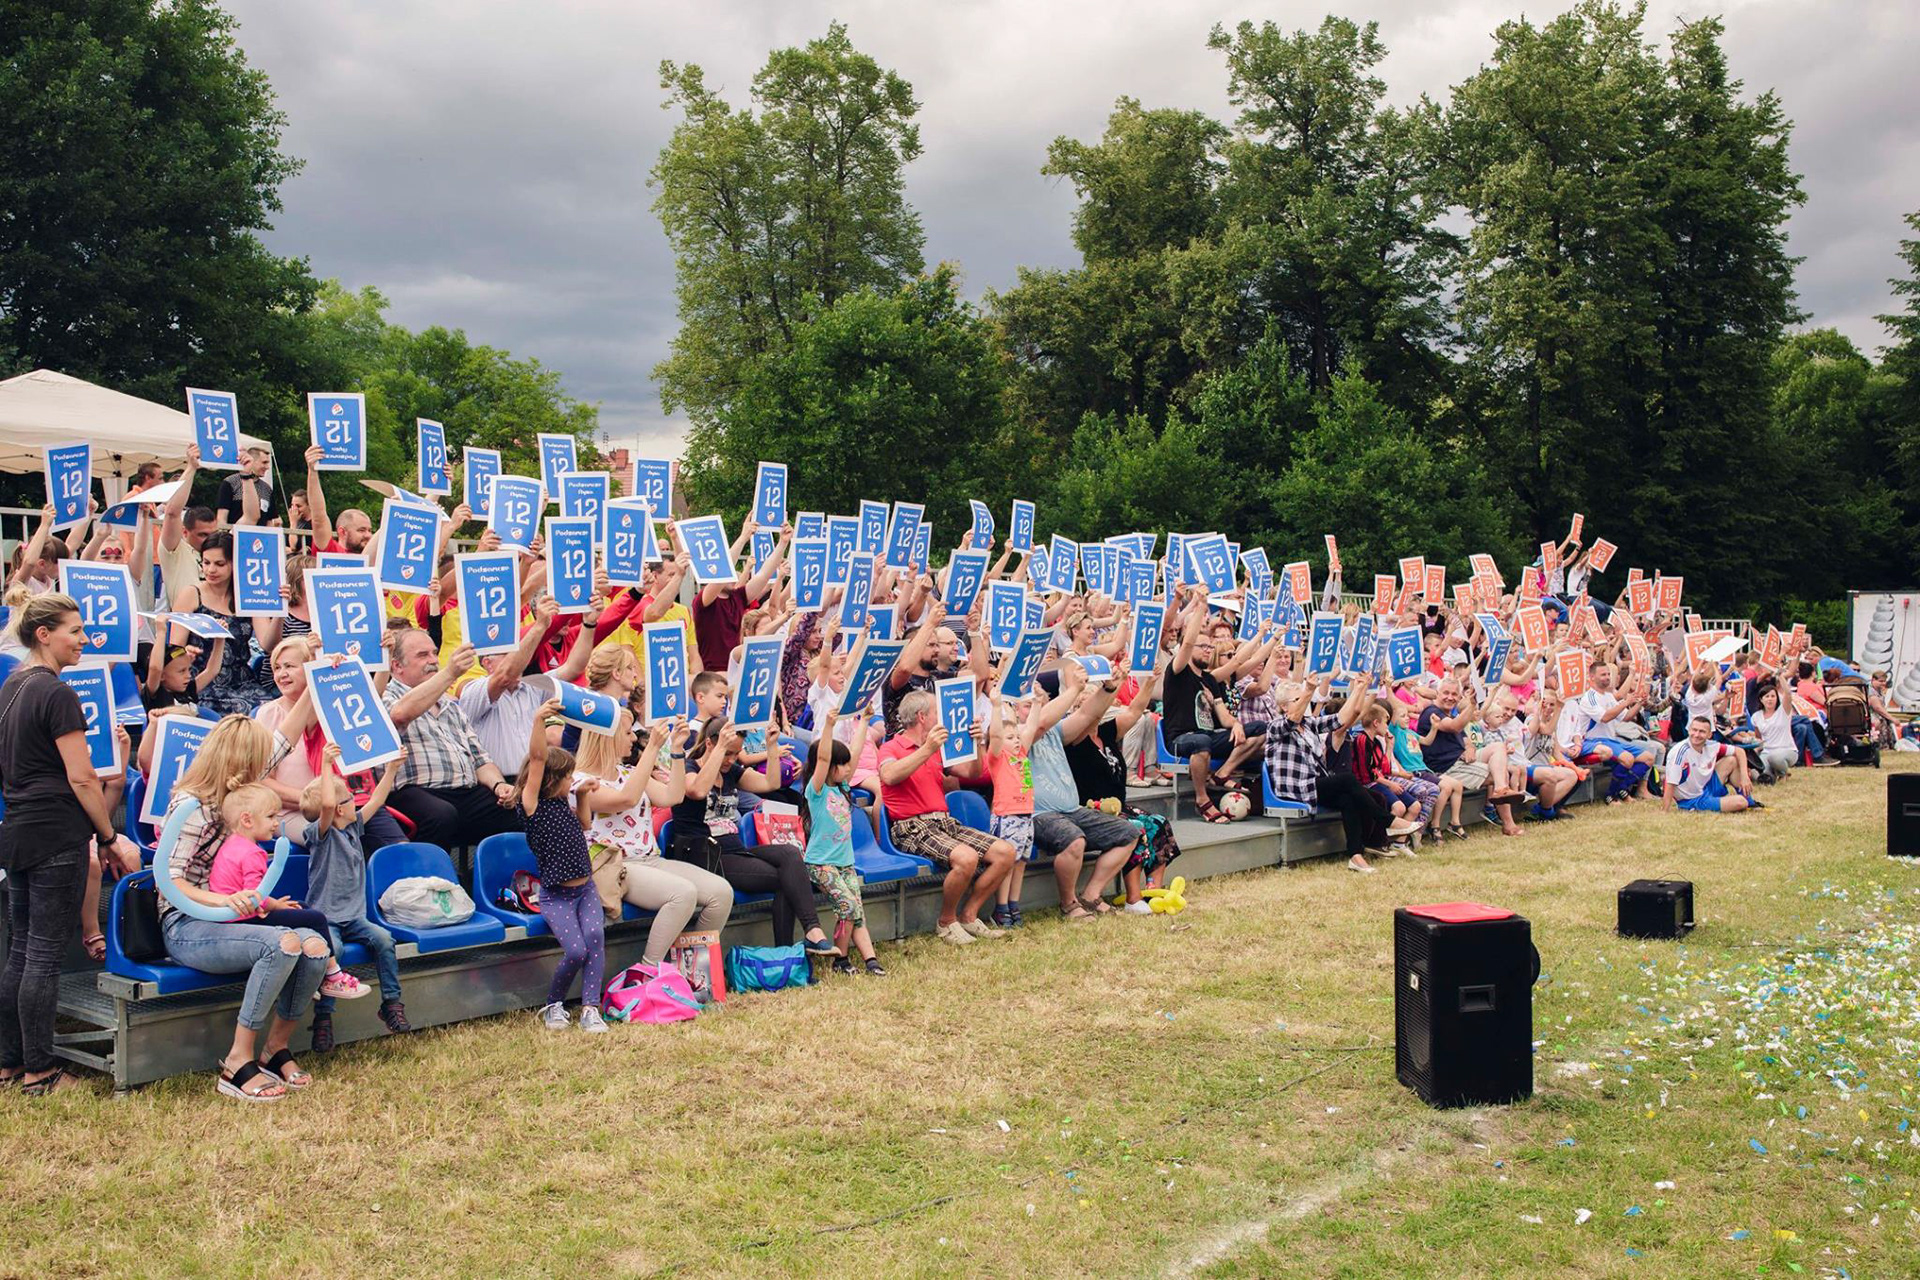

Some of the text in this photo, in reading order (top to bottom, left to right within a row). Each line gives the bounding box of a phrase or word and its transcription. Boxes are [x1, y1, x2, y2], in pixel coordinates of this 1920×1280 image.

[204, 417, 228, 440] 12
[325, 420, 351, 443] 12
[427, 446, 442, 468] 12
[551, 458, 569, 477] 12
[61, 471, 82, 498] 12
[475, 473, 490, 494] 12
[644, 479, 663, 499] 12
[765, 487, 780, 507] 12
[504, 501, 530, 525] 12
[574, 499, 597, 520] 12
[868, 522, 881, 539] 12
[979, 518, 989, 534] 12
[1019, 519, 1029, 535] 12
[397, 533, 425, 561] 12
[615, 533, 636, 557] 12
[897, 527, 913, 547] 12
[695, 539, 719, 560] 12
[759, 543, 771, 561] 12
[836, 541, 852, 562] 12
[917, 543, 924, 559] 2
[246, 559, 271, 585] 12
[562, 550, 585, 578] 12
[1033, 562, 1047, 577] 12
[1057, 555, 1070, 574] 12
[1087, 560, 1099, 575] 12
[1204, 556, 1225, 575] 12
[803, 564, 819, 586] 12
[1296, 576, 1306, 590] 12
[1409, 570, 1420, 582] 12
[1431, 579, 1440, 591] 12
[852, 580, 867, 604] 12
[955, 576, 975, 596] 12
[1136, 579, 1149, 596] 12
[1486, 585, 1494, 597] 12
[1666, 589, 1676, 599] 12
[476, 587, 506, 618] 12
[1281, 590, 1290, 608] 12
[1380, 590, 1389, 603] 12
[1636, 592, 1647, 603] 12
[81, 596, 118, 626] 12
[331, 602, 368, 634] 12
[999, 606, 1016, 627] 12
[1248, 609, 1257, 626] 12
[1140, 627, 1155, 649] 12
[1489, 626, 1500, 638] 12
[1530, 621, 1542, 636] 12
[1319, 637, 1334, 656] 12
[1359, 636, 1368, 654] 12
[1020, 653, 1042, 677] 12
[1396, 646, 1415, 665] 12
[1493, 654, 1505, 669] 12
[658, 657, 680, 687] 12
[748, 668, 770, 696] 12
[858, 668, 885, 693] 12
[1567, 668, 1580, 683] 12
[85, 702, 100, 735] 2
[332, 694, 372, 730] 12
[949, 707, 968, 734] 12
[175, 754, 191, 786] 1
[680, 935, 714, 944] DYPLOM
